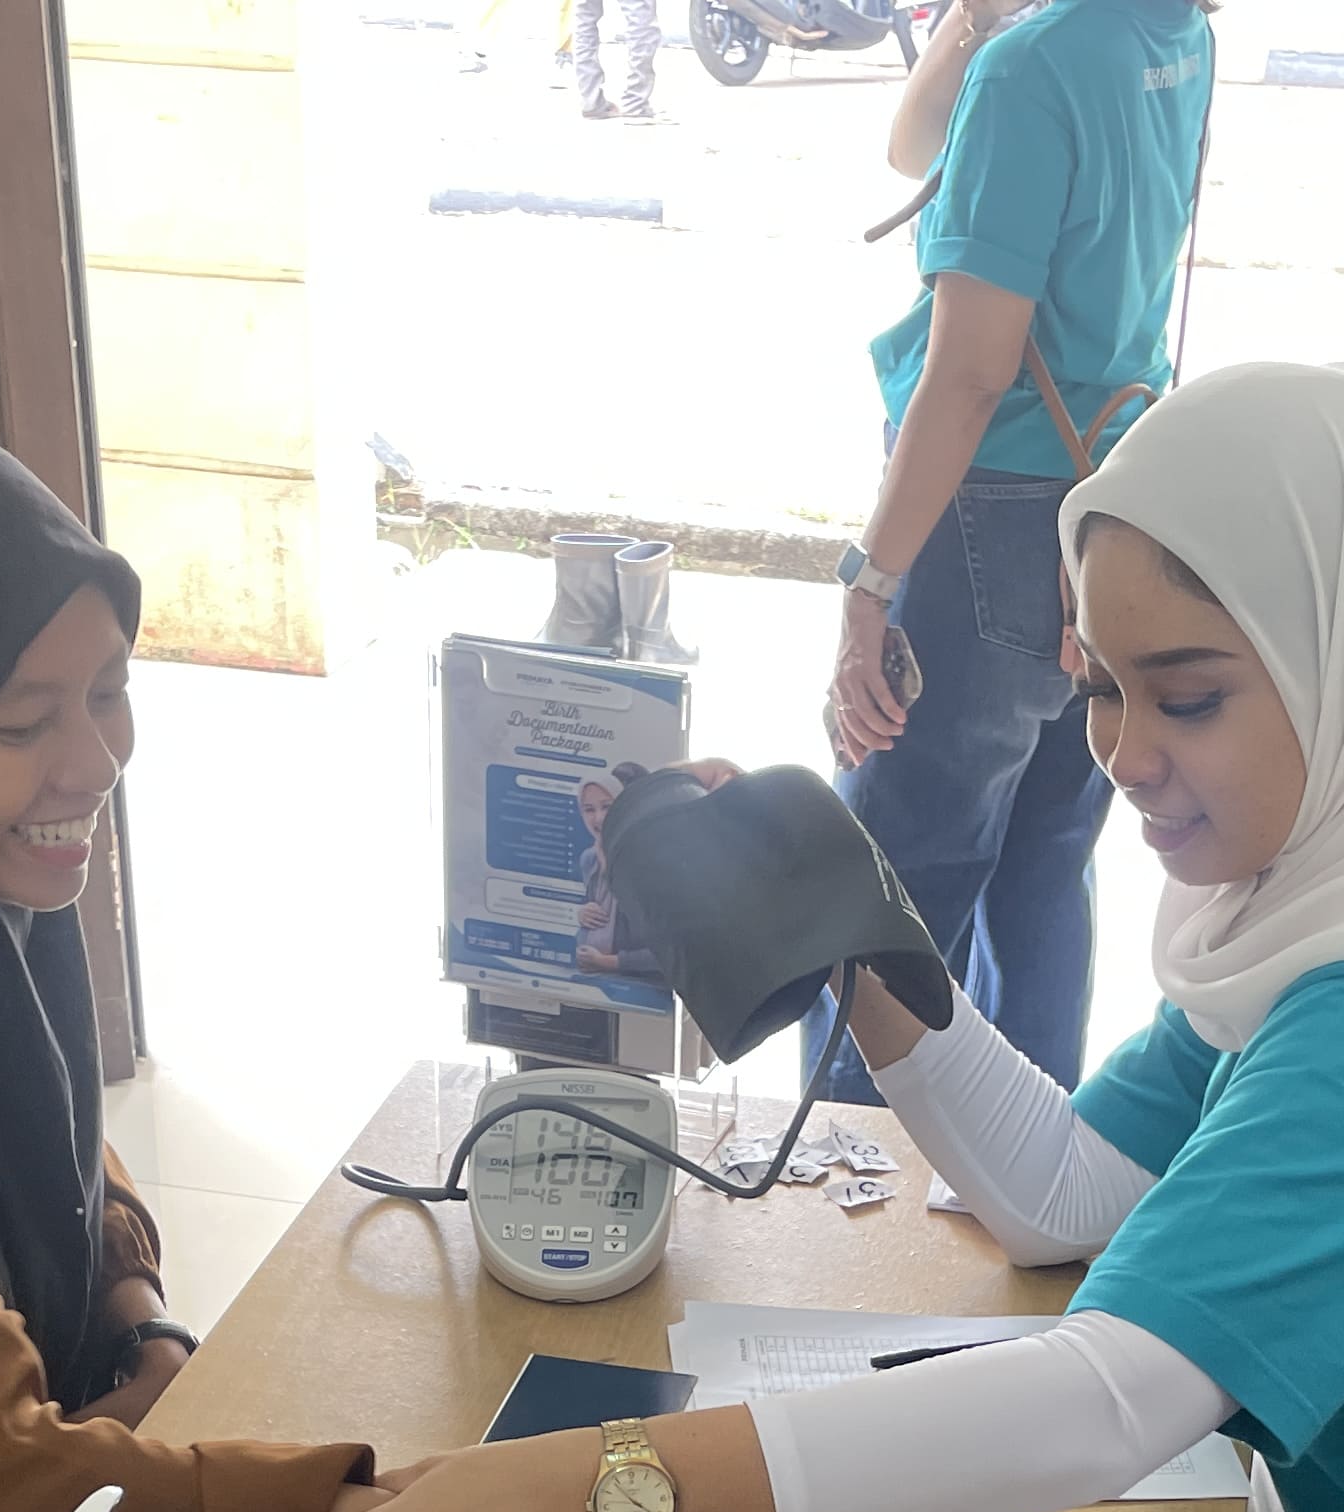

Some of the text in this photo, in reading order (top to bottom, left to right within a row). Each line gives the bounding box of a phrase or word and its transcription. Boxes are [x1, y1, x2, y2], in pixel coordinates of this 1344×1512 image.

[541, 700, 581, 720] Birth
[506, 710, 616, 741] Documentation
[531, 729, 592, 755] Package
[561, 1083, 596, 1094] NISSEI
[490, 1158, 511, 1167] DIA
